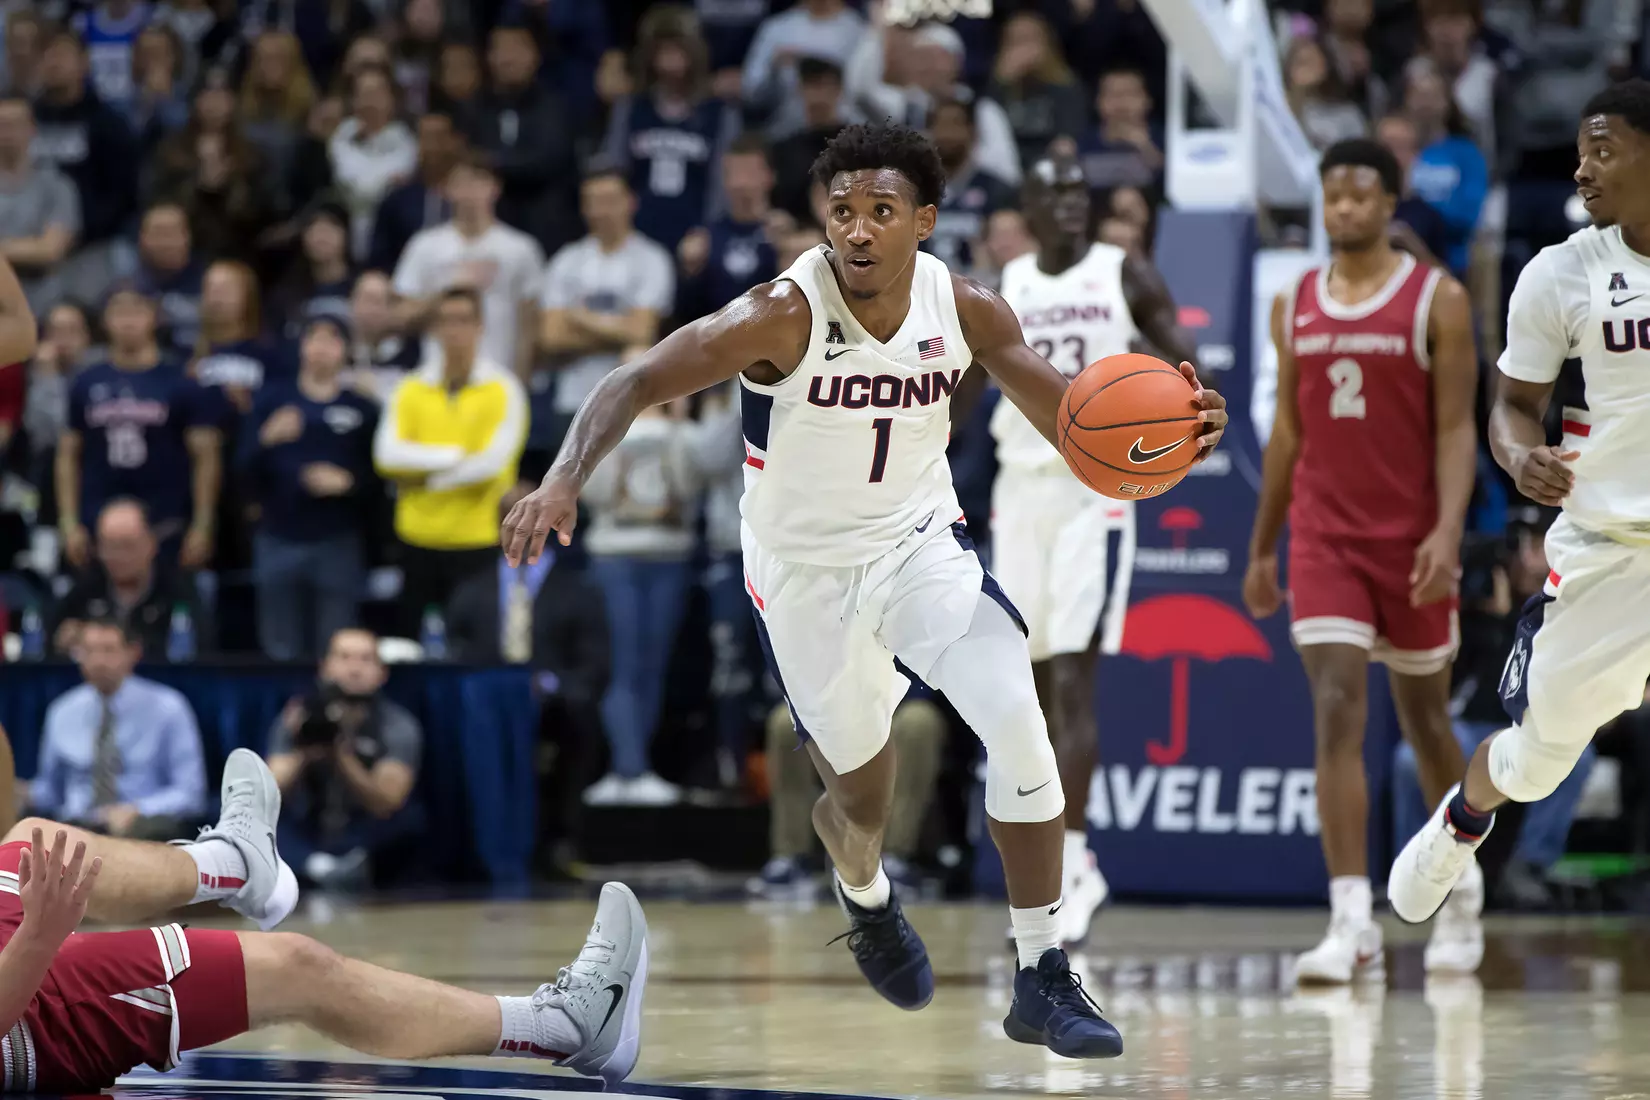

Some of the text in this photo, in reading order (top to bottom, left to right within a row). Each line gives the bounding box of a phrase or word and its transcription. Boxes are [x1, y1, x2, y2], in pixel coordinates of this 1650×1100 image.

[807, 369, 961, 409] UCONN
[1326, 358, 1367, 420] 2
[868, 418, 893, 483] 1
[1117, 481, 1178, 495] ELIT
[1085, 763, 1321, 835] AVELER
